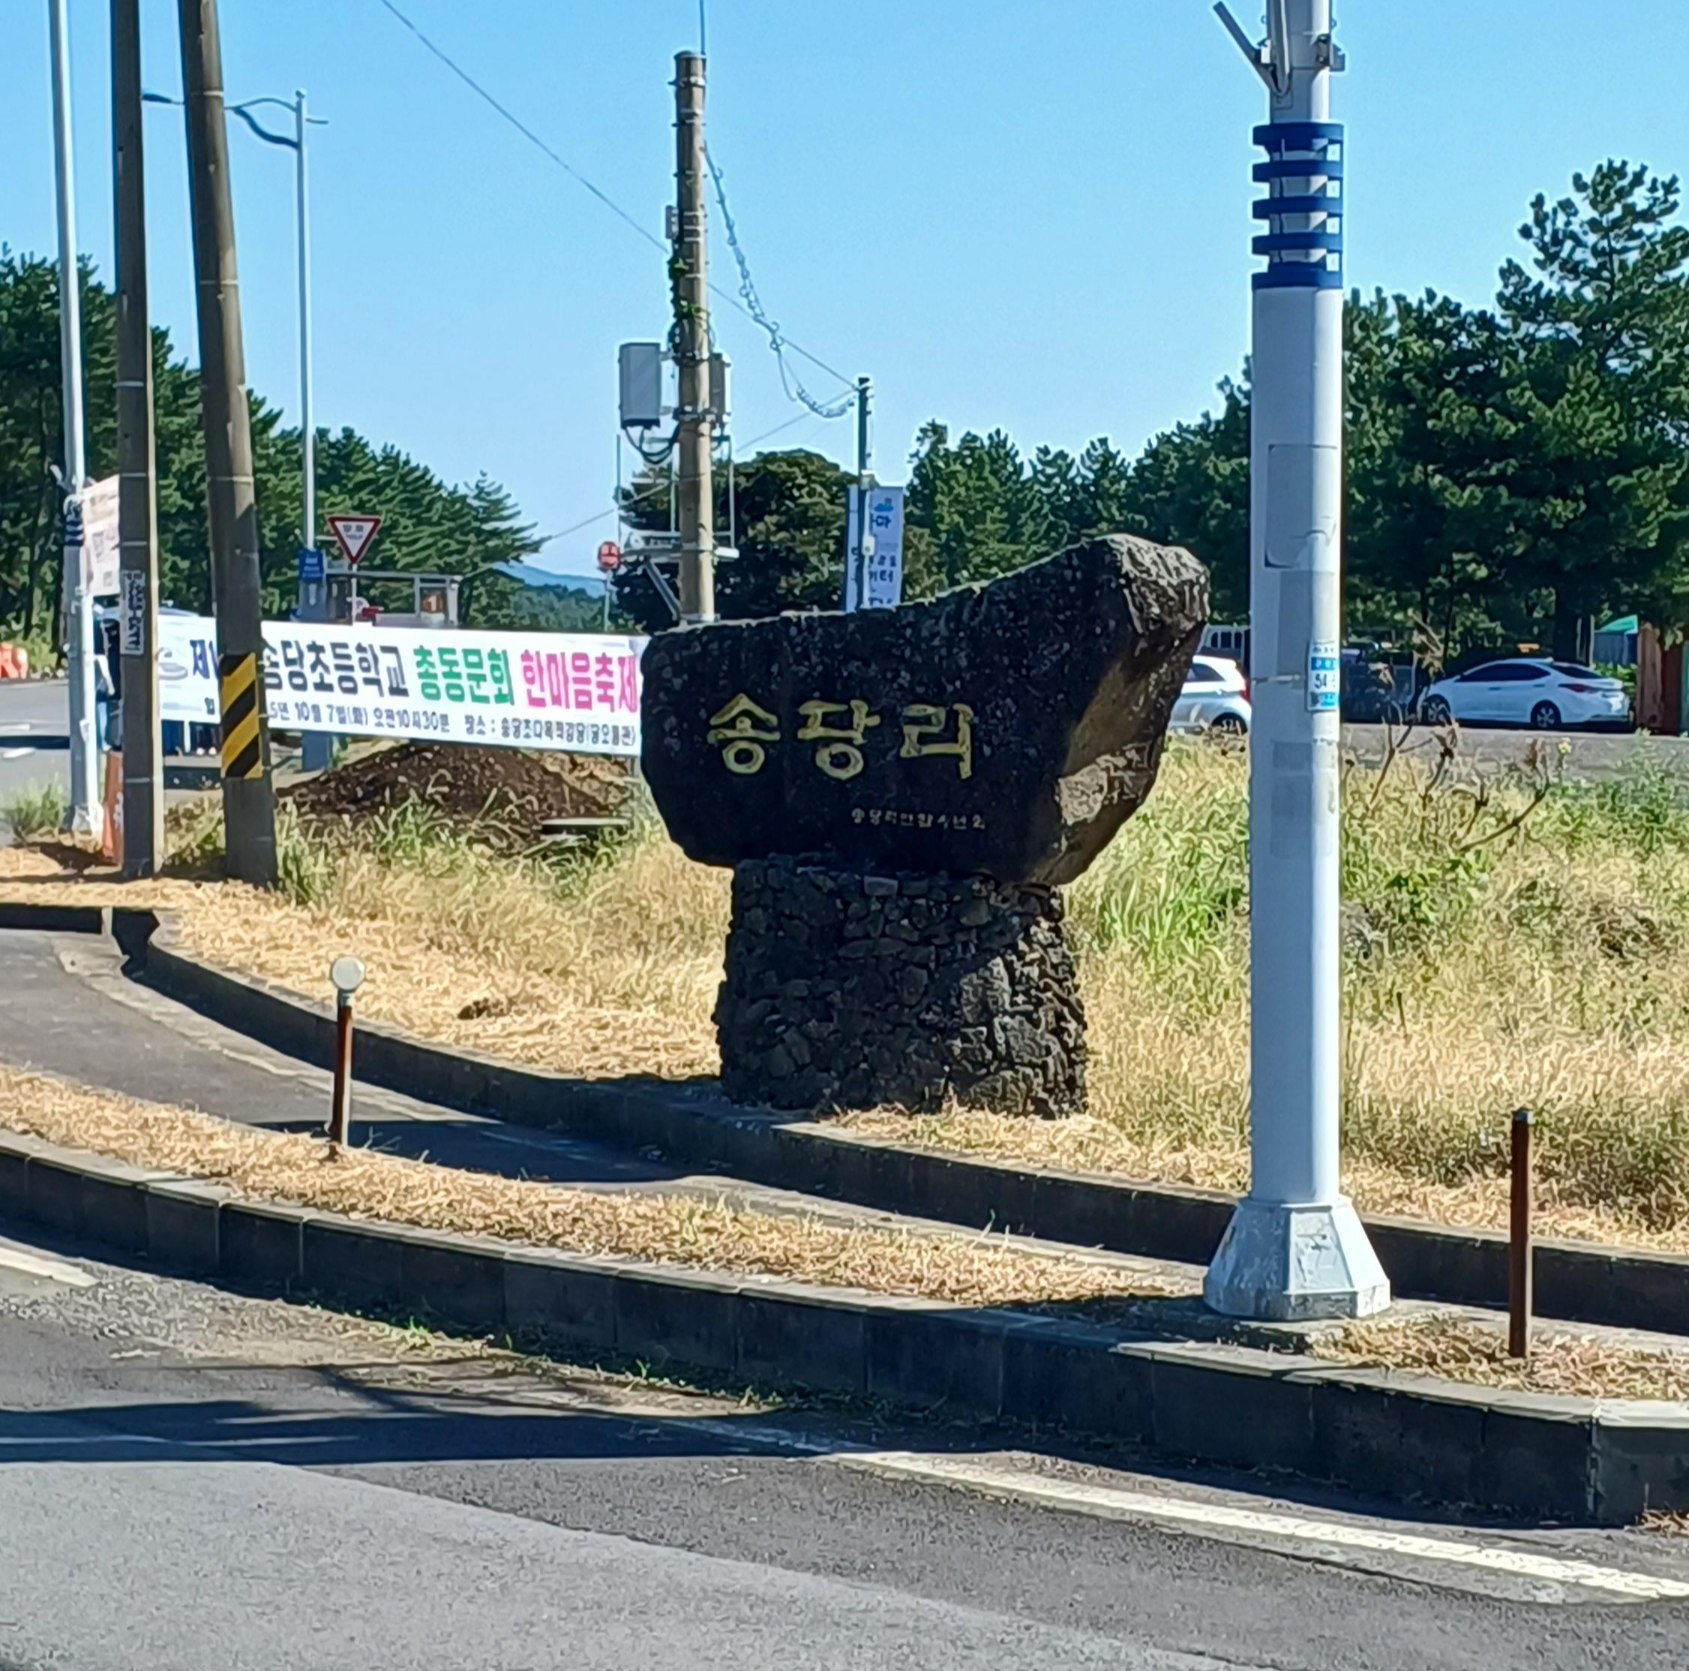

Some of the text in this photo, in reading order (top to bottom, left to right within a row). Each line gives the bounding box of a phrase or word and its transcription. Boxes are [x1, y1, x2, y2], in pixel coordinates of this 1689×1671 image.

[262, 640, 409, 697] 송당초등학교
[413, 645, 515, 705] 총동문회
[520, 649, 638, 713] 한마음축제
[294, 701, 322, 723] 10월
[707, 692, 979, 780] 송당리
